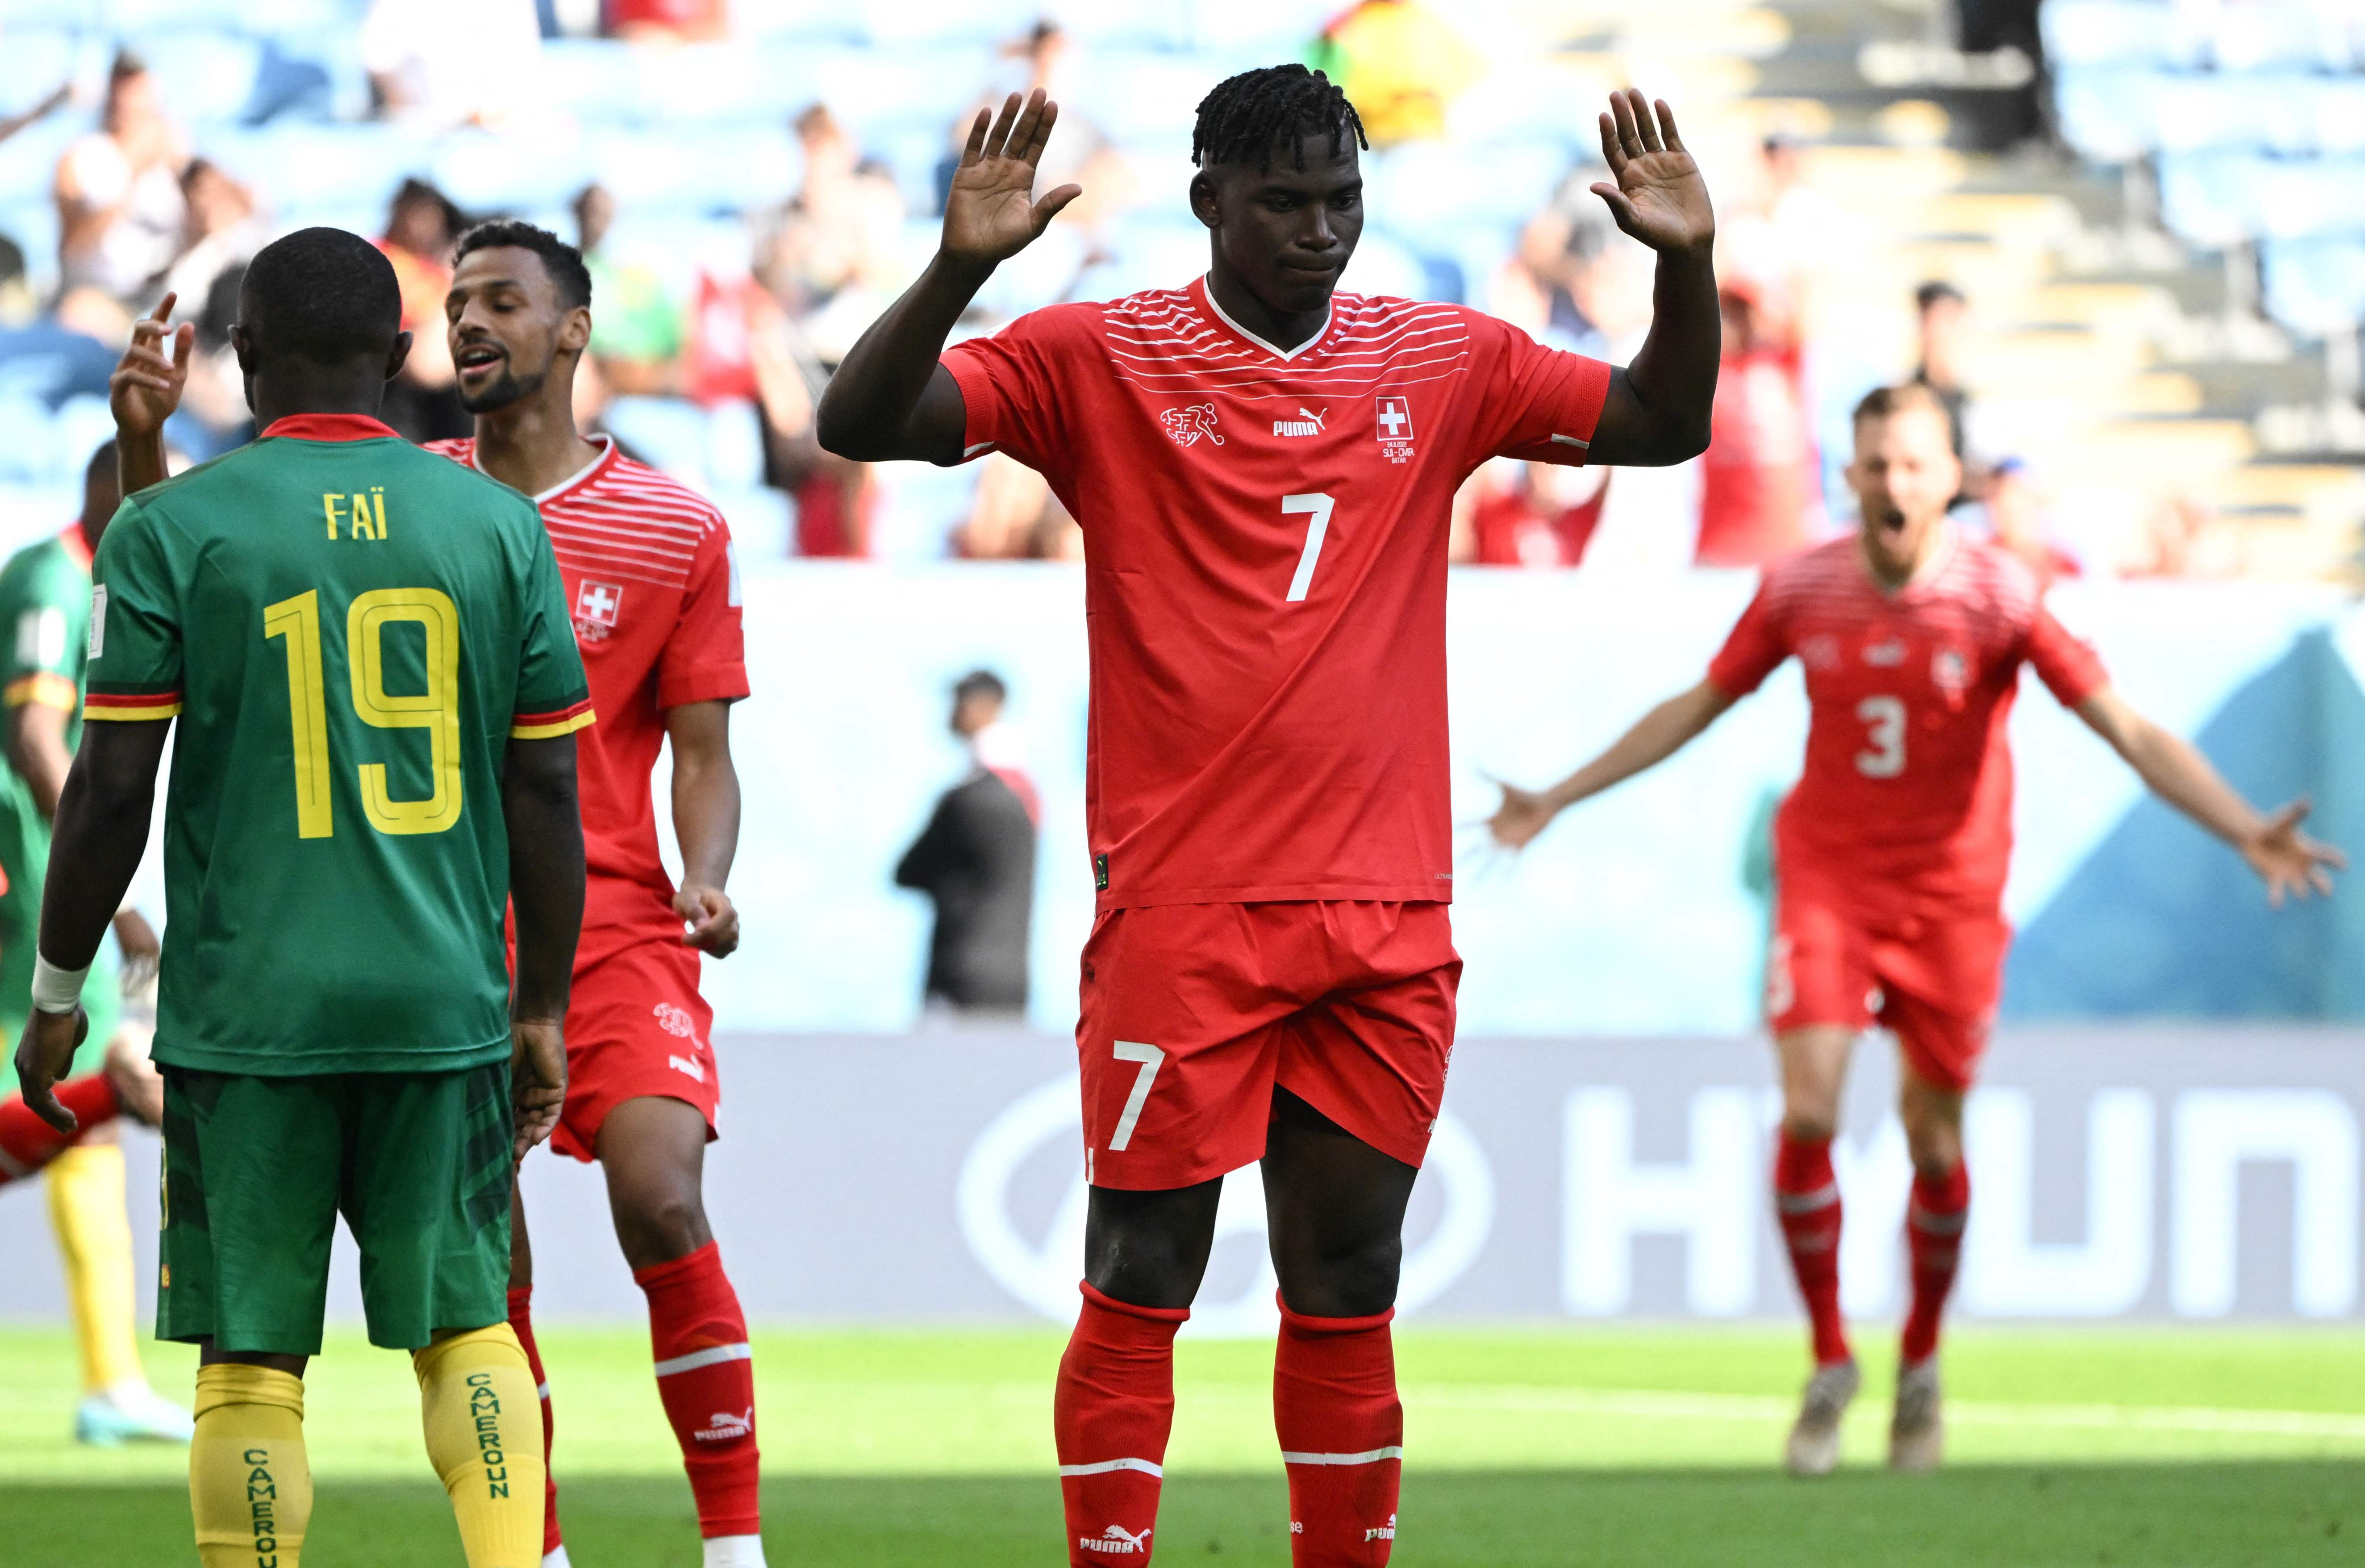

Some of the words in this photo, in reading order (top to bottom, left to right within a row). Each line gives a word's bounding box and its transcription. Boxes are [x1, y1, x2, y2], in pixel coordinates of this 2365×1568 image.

[1273, 421, 1318, 436] PUMA
[323, 486, 387, 540] FAÏ
[1282, 492, 1335, 602] 7
[264, 587, 462, 838] 19
[1854, 693, 1907, 779] 3
[1108, 1040, 1166, 1151] 7
[466, 1373, 509, 1499] CAMEROUN
[694, 1426, 745, 1441] PUMA
[1080, 1537, 1134, 1553] PUMA
